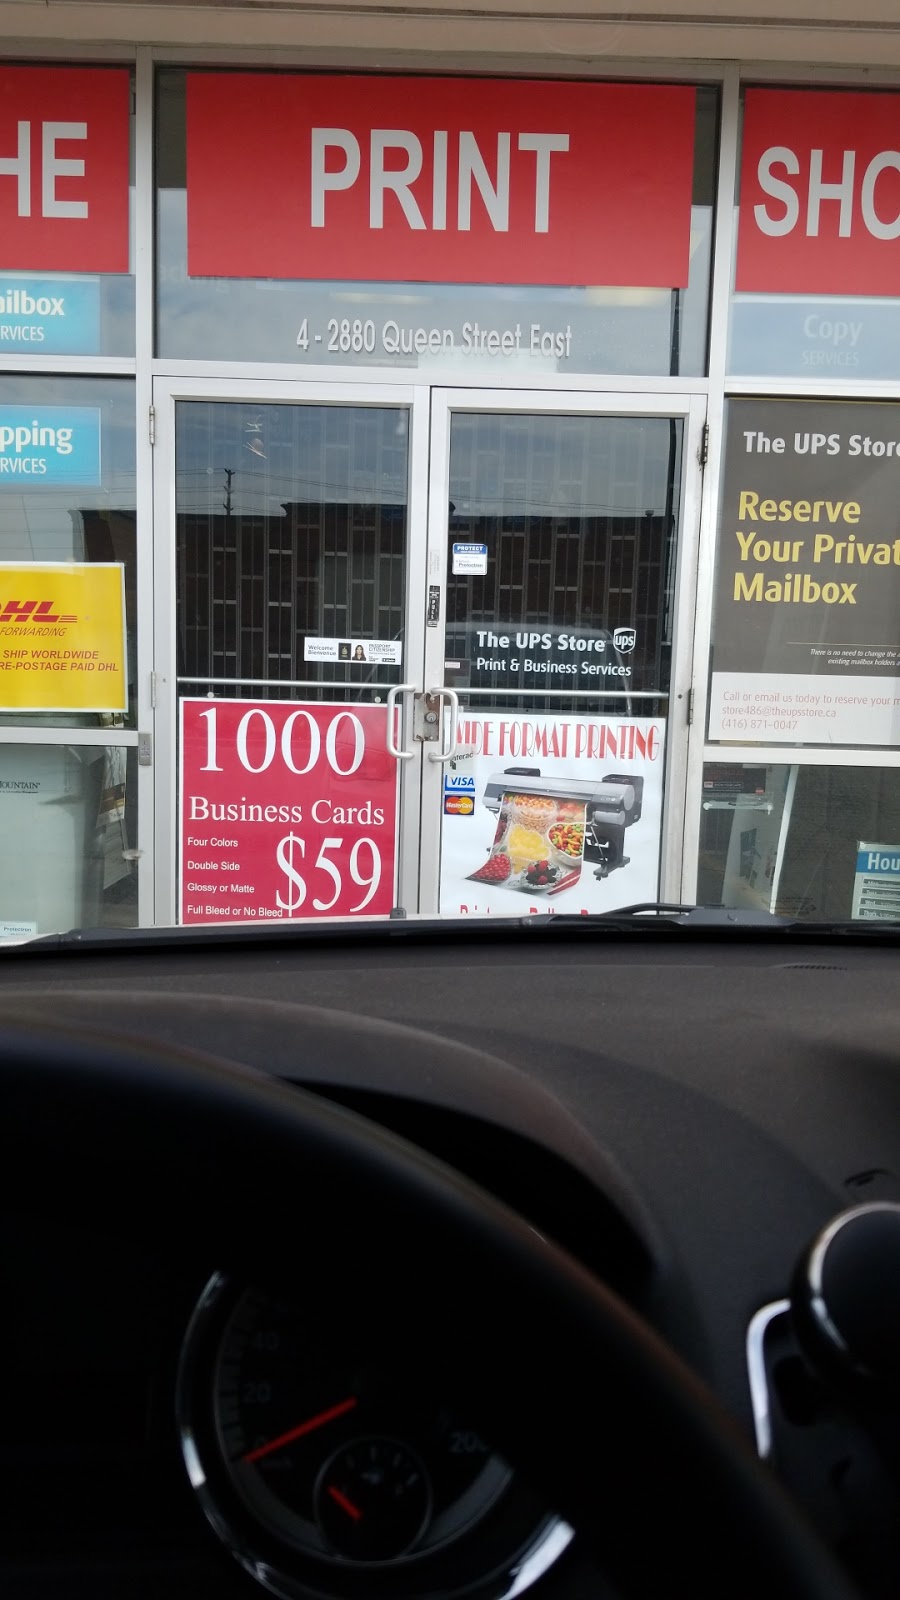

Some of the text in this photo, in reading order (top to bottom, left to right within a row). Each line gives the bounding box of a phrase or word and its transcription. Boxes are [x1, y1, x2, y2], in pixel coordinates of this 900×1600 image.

[310, 127, 570, 233] PRINT
[753, 146, 900, 240] SHO
[296, 319, 308, 351] 4
[327, 319, 376, 353] 2880
[382, 320, 454, 354] Queen
[461, 322, 522, 356] Street
[530, 324, 573, 357] East
[804, 314, 863, 345] Copy
[802, 351, 860, 367] SERVICES
[743, 431, 900, 457] The UPS Stor
[738, 491, 861, 524] Reserve
[735, 532, 900, 566] Your Privat
[733, 572, 858, 605] Mailbox
[0, 601, 62, 623] HL
[0, 627, 67, 637] FORWARDING
[476, 631, 605, 653] The UPS Store
[615, 635, 634, 650] ups
[3, 650, 99, 660] SHIP WORLDWIDE
[810, 648, 826, 656] There
[70, 662, 95, 671] PAID
[97, 662, 119, 671] DHL
[476, 657, 632, 677] Print & Business Services
[828, 658, 850, 666] existing
[723, 691, 740, 701] Call
[742, 693, 752, 702] or
[754, 692, 780, 702] email
[782, 695, 793, 703] us
[795, 693, 820, 705] today
[823, 695, 832, 704] to
[834, 696, 868, 705] reserve
[870, 697, 891, 707] your
[722, 705, 837, 718] store486@theupsstore.ca
[721, 718, 798, 730] (416) 871-0047
[199, 707, 365, 776] 1000
[499, 721, 571, 758] FORMAT
[575, 723, 660, 762] PRINTING
[0, 781, 38, 789] OUNTAIN
[451, 776, 475, 786] VISA
[188, 796, 385, 826] Business Cards
[187, 837, 238, 848] Four Colors
[187, 861, 240, 871] Double Side
[867, 852, 900, 871] Hou
[275, 831, 382, 918] $59
[187, 882, 217, 894] Glossy
[230, 883, 255, 893] Matte
[187, 904, 283, 917] Full Bleed or No Bleed
